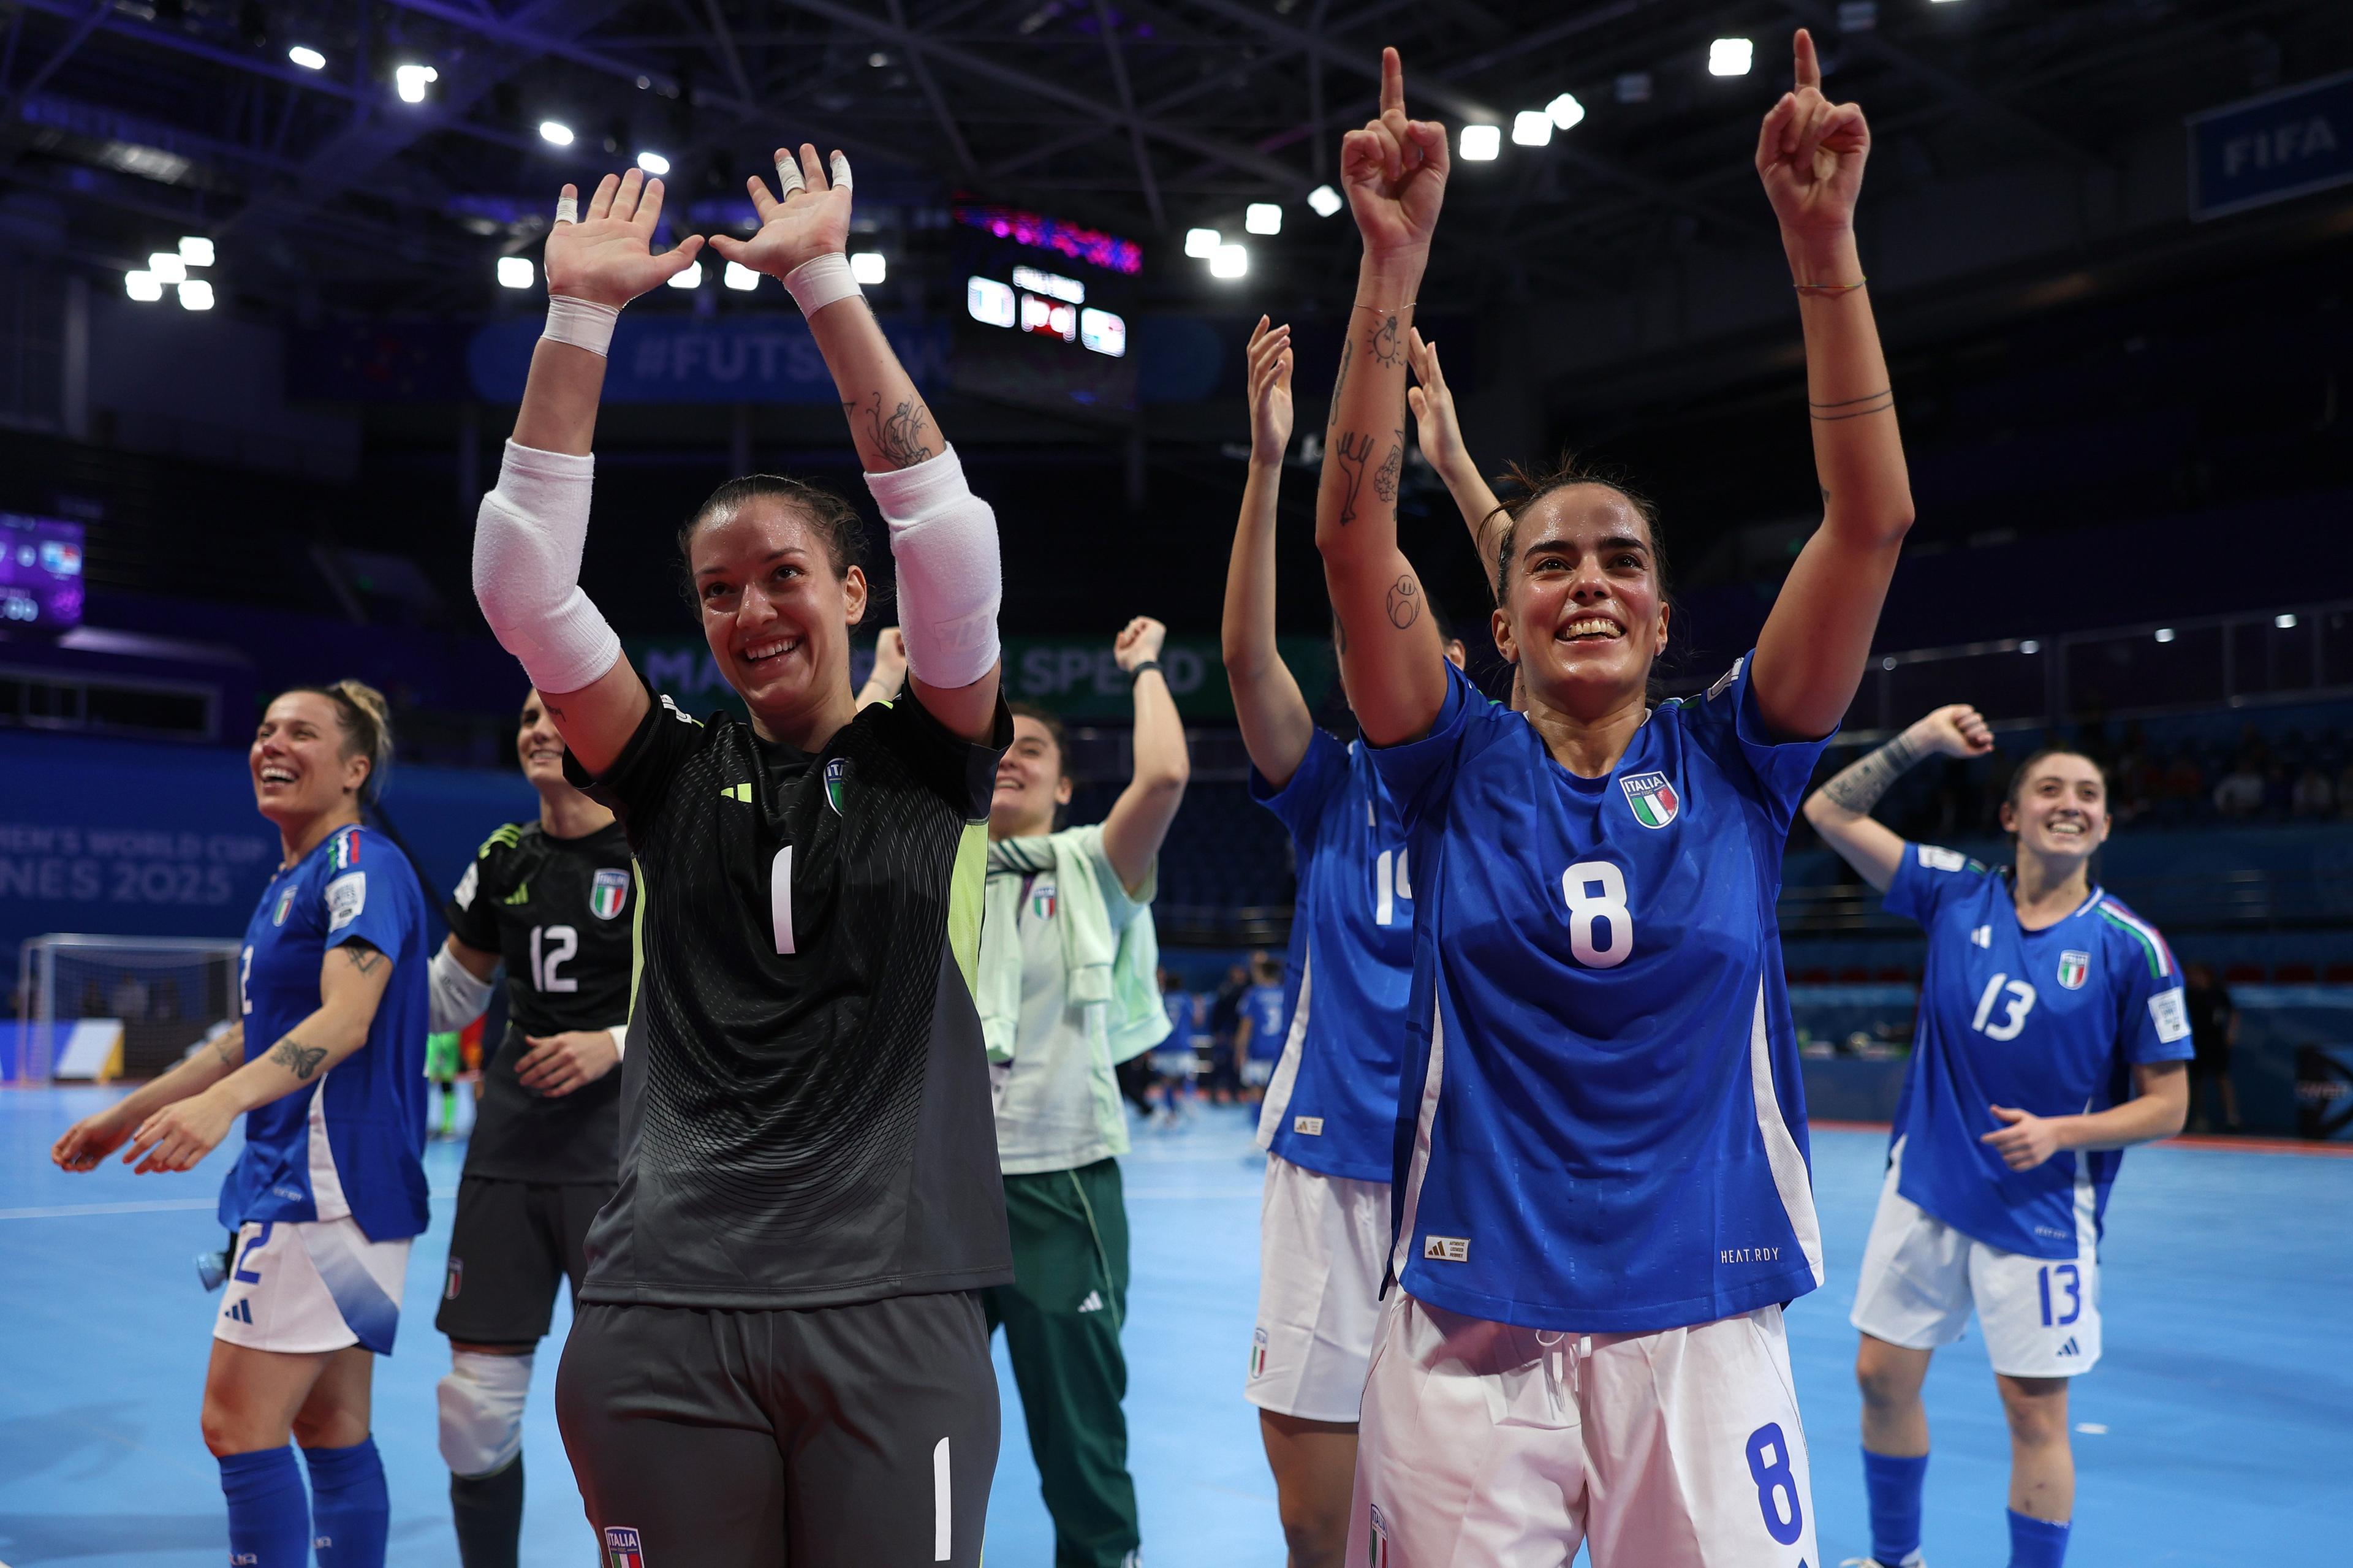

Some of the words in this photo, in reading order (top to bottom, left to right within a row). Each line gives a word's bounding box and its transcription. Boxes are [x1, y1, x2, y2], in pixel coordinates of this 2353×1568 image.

[2223, 115, 2336, 179] FIFA
[1018, 645, 1207, 696] SPED
[1624, 776, 1664, 792] ITALIA
[111, 862, 234, 905] 2025
[771, 845, 795, 954] 1
[1562, 861, 1633, 969] 8
[529, 924, 578, 993] 12
[1971, 972, 2037, 1042] 13
[235, 1221, 272, 1284] 2
[1721, 1248, 1778, 1263] HEAT.RDY
[2039, 1264, 2080, 1325] 13
[933, 1437, 952, 1562] 1
[1746, 1422, 1802, 1545] 8
[607, 1532, 637, 1547] ITALIA
